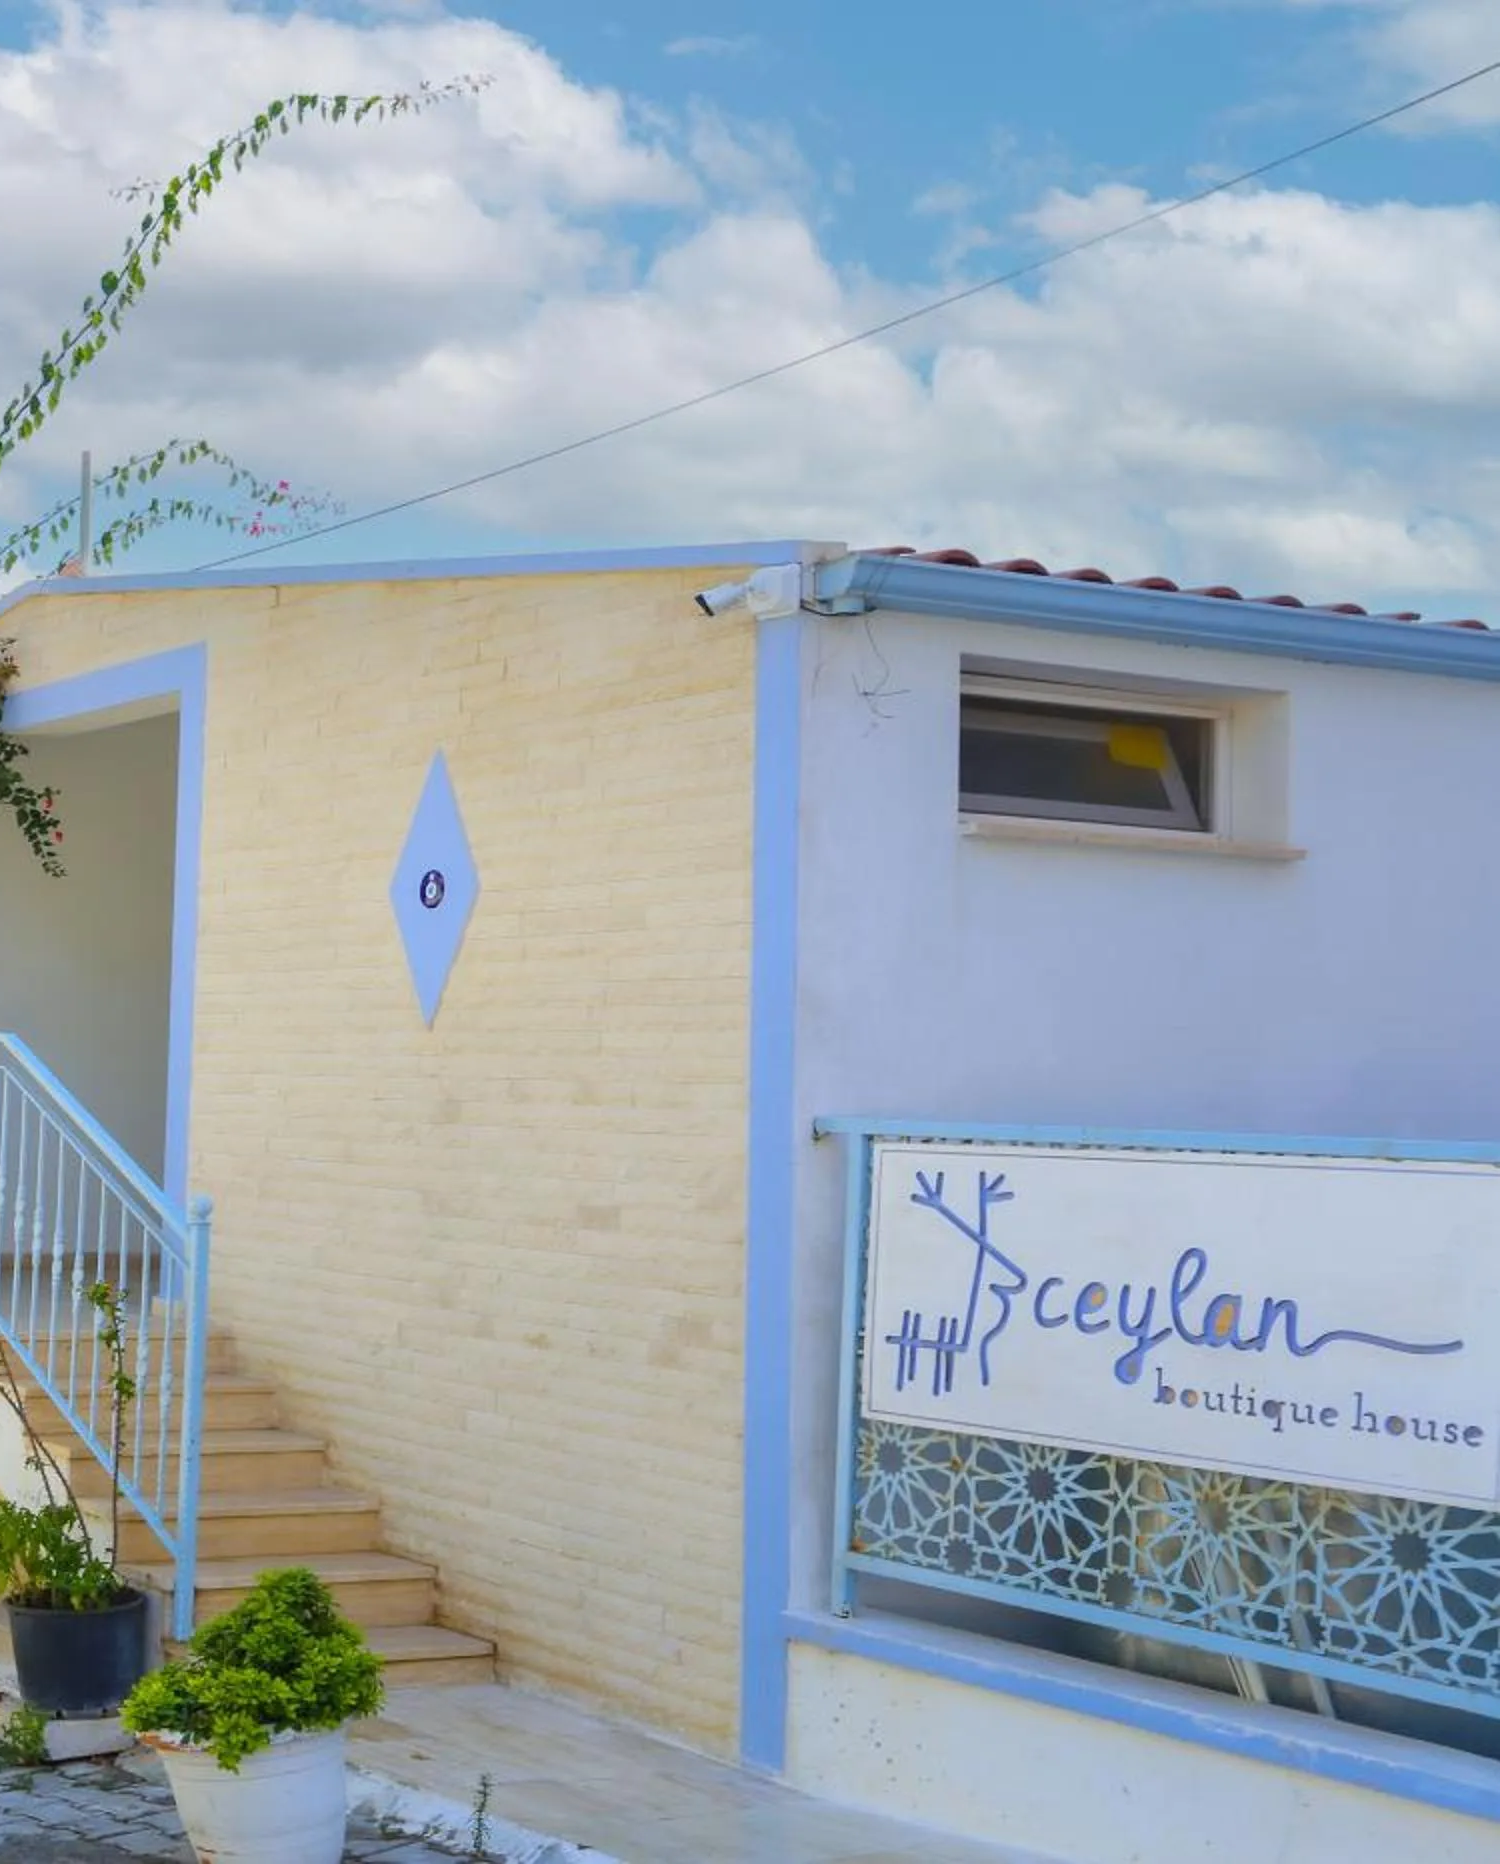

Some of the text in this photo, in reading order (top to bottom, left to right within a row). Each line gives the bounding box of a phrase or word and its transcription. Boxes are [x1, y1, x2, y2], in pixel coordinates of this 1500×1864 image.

[1033, 1247, 1464, 1385] ceylan
[1153, 1368, 1485, 1448] boutique house
